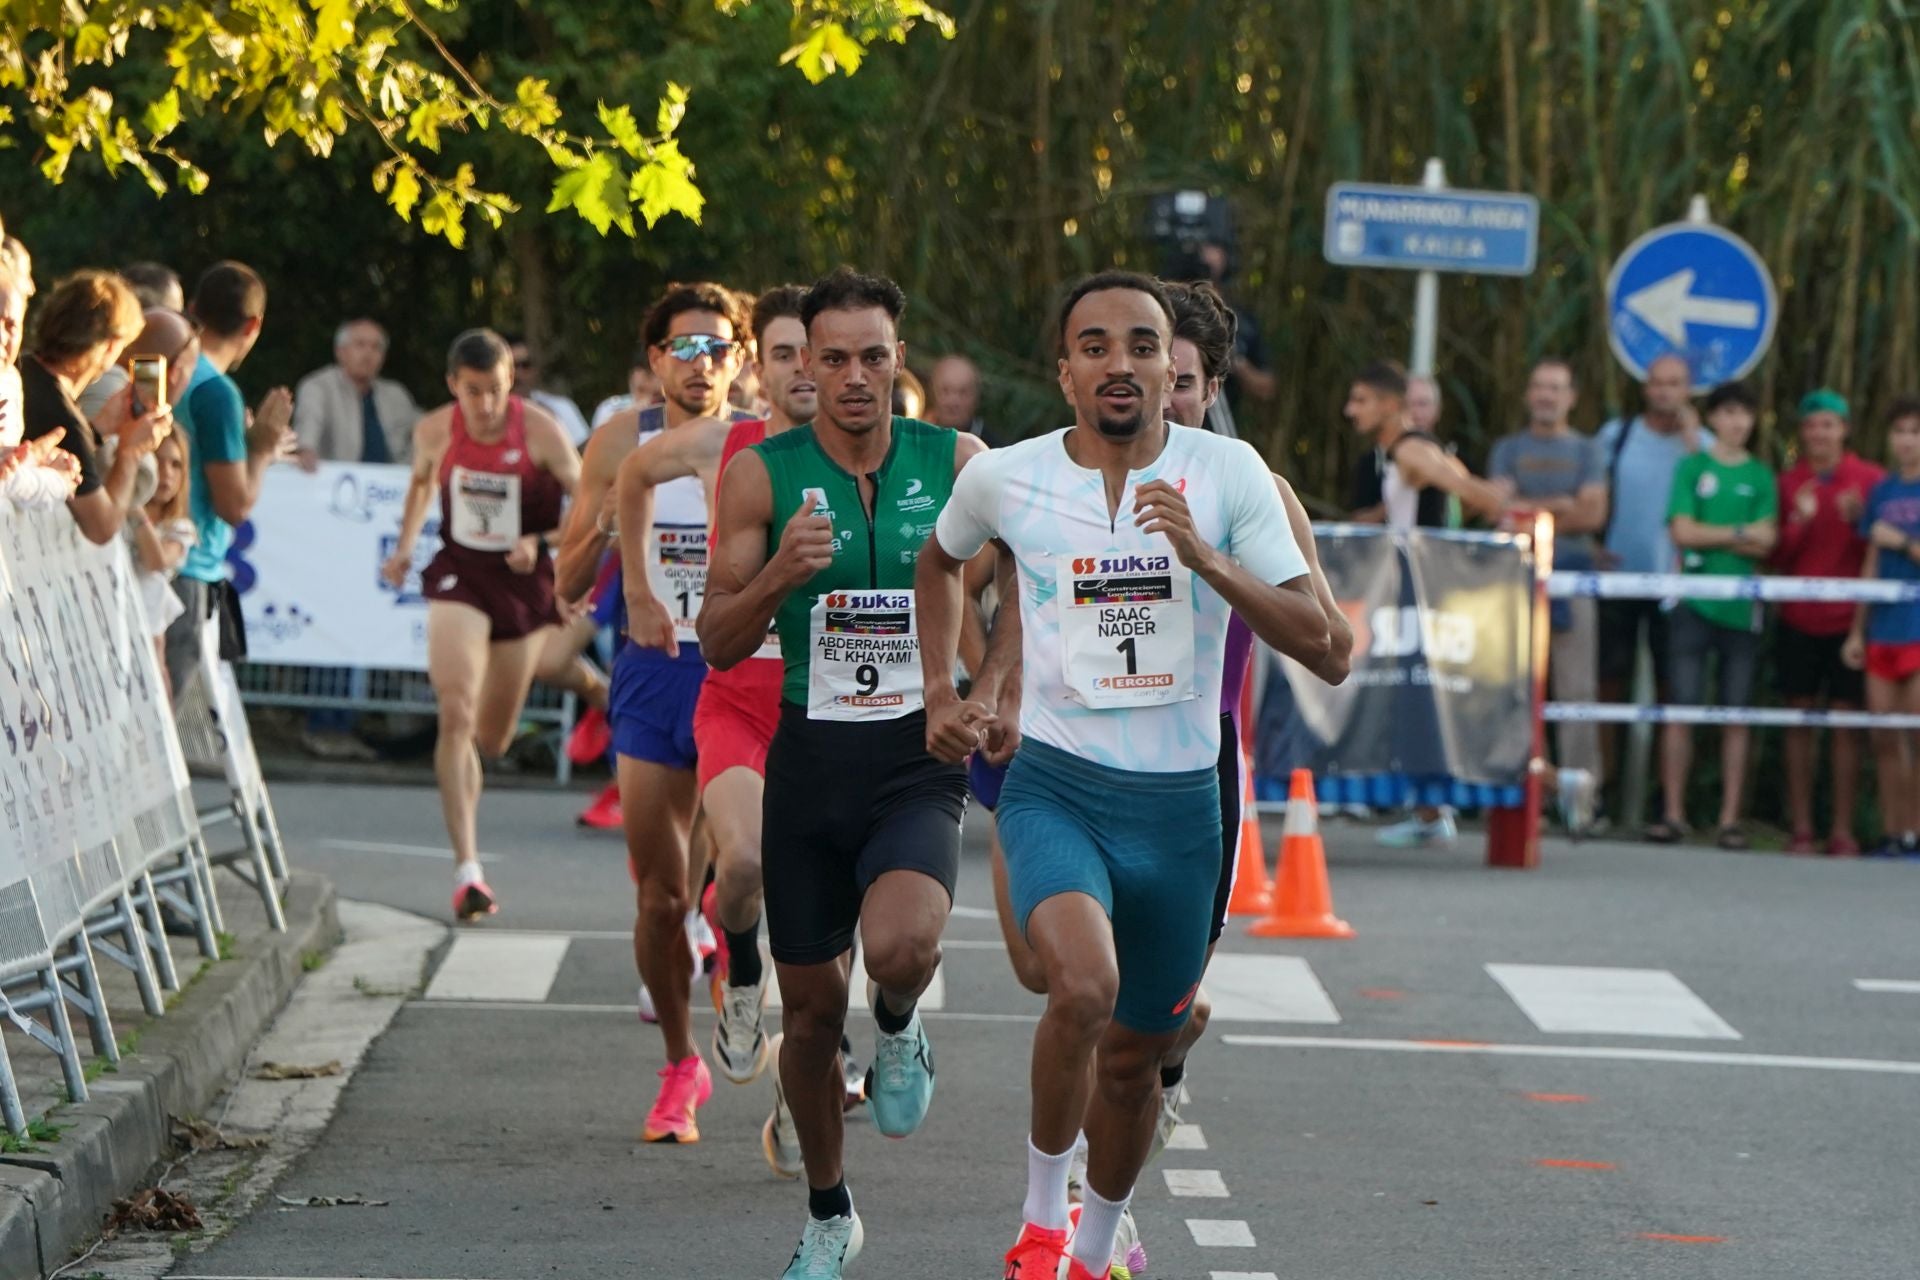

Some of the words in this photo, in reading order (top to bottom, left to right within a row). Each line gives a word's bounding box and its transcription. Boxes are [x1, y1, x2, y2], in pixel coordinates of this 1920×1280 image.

[1101, 584, 1167, 592] Construcciones
[676, 591, 705, 618] 1
[1100, 606, 1151, 623] ISAAC
[1098, 621, 1156, 638] NADER
[818, 636, 919, 651] ABDERRAHMAN
[823, 648, 841, 662] EL
[845, 650, 912, 664] KHAYAMI
[1116, 637, 1137, 675] 1
[855, 664, 880, 697] 9
[1116, 675, 1170, 688] EROSKI
[855, 695, 900, 706] EROSKI
